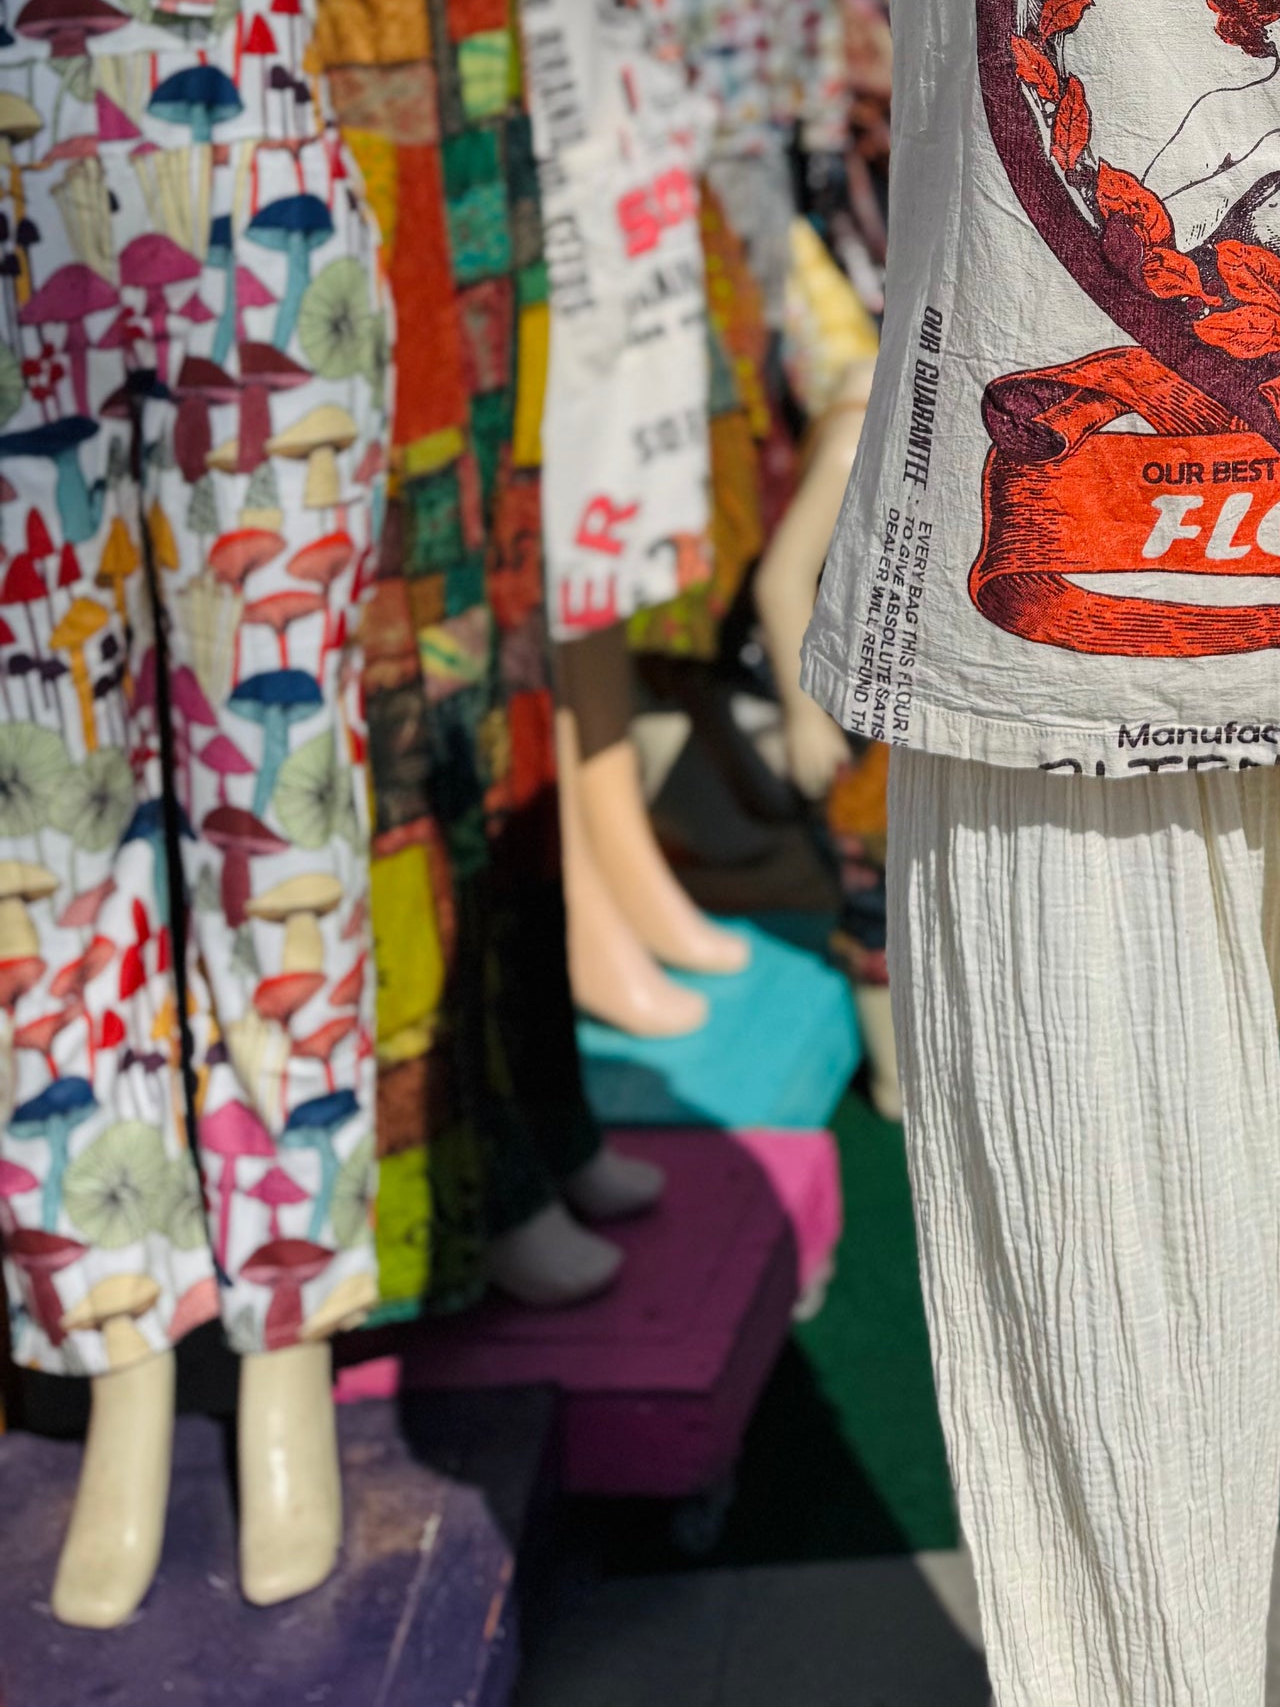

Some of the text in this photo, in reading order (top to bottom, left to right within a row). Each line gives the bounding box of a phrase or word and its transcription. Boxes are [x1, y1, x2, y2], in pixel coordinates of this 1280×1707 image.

[918, 305, 943, 355] OUR
[1142, 460, 1205, 485] OUR
[1212, 456, 1280, 484] BEST
[875, 507, 900, 582] DEALER
[903, 515, 916, 540] TO
[912, 520, 933, 583] EVERY
[892, 543, 911, 588] GIVE
[866, 584, 886, 630] WILL
[906, 584, 924, 625] BAG
[876, 589, 901, 685] ABSOLUTE
[899, 628, 918, 669] THIS
[853, 631, 876, 704] REFUND
[893, 671, 913, 732] FLOUR
